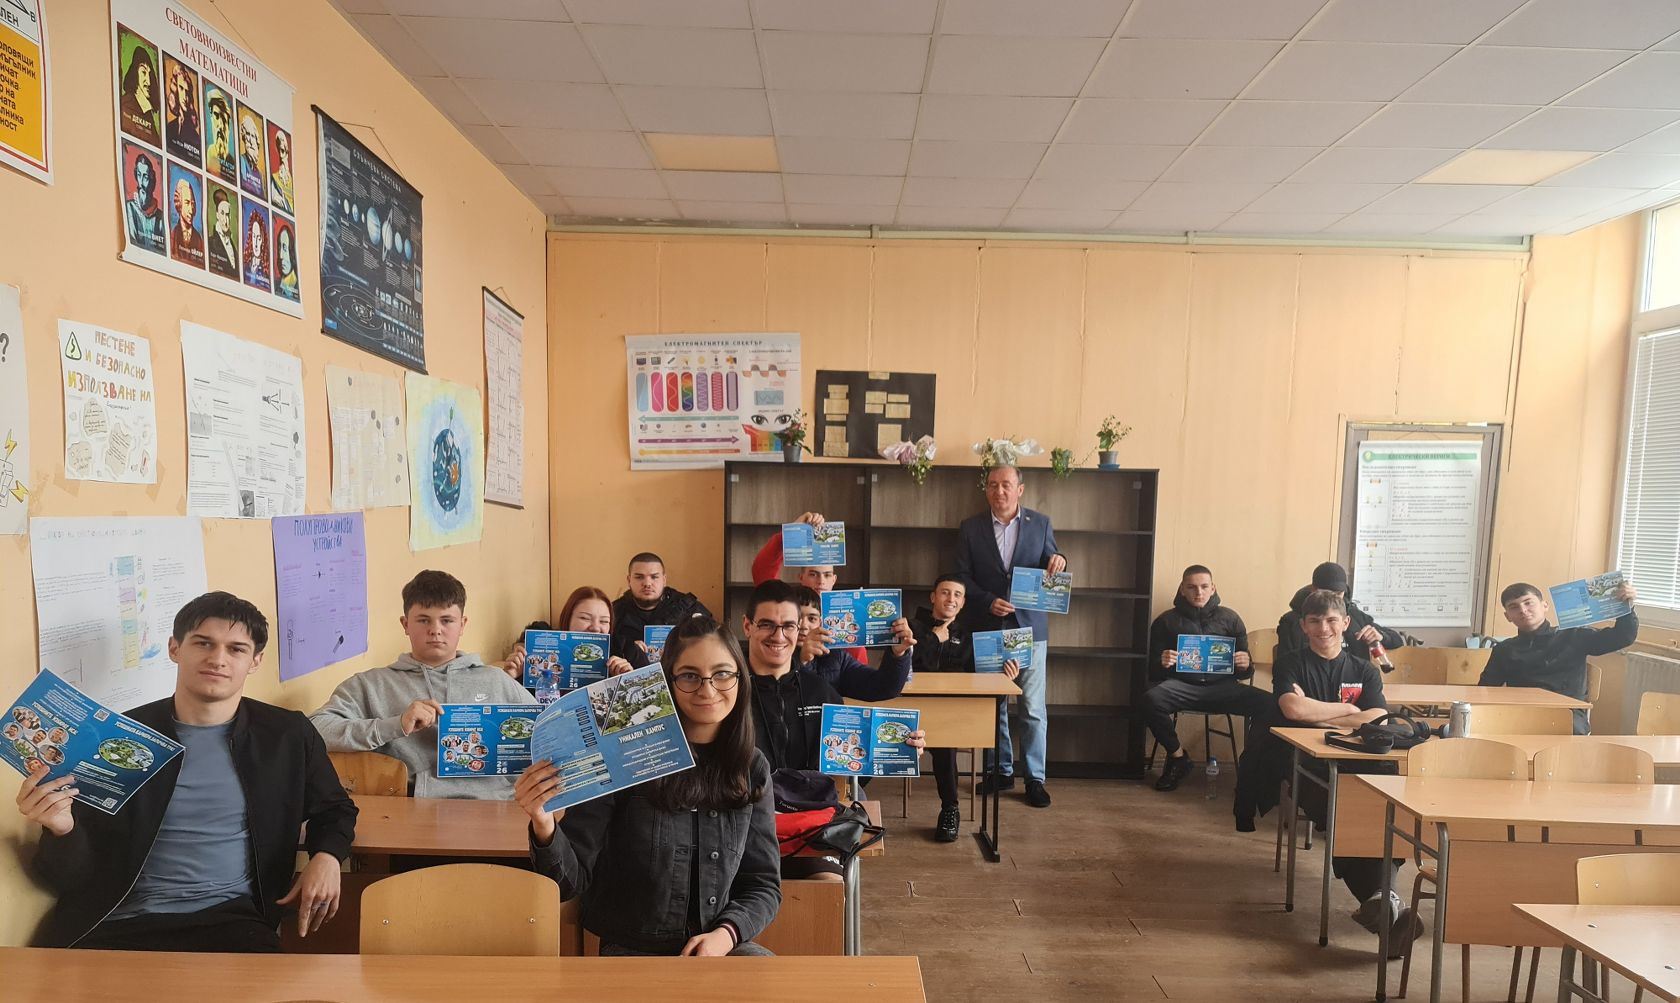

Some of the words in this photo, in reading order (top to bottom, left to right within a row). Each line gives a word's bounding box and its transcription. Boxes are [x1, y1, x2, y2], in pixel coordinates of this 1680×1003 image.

[165, 7, 257, 82] СВЕТОВНОИЗВЕСТНИ
[179, 38, 249, 99] МАТЕМАТИЦИ
[95, 330, 136, 356] ПЕСТЕНЕ
[85, 349, 92, 362] И
[96, 353, 146, 380] БЕЗОПАСНО
[68, 370, 137, 402] ИЗПОЛЗВАНЕ
[140, 390, 151, 402] НА
